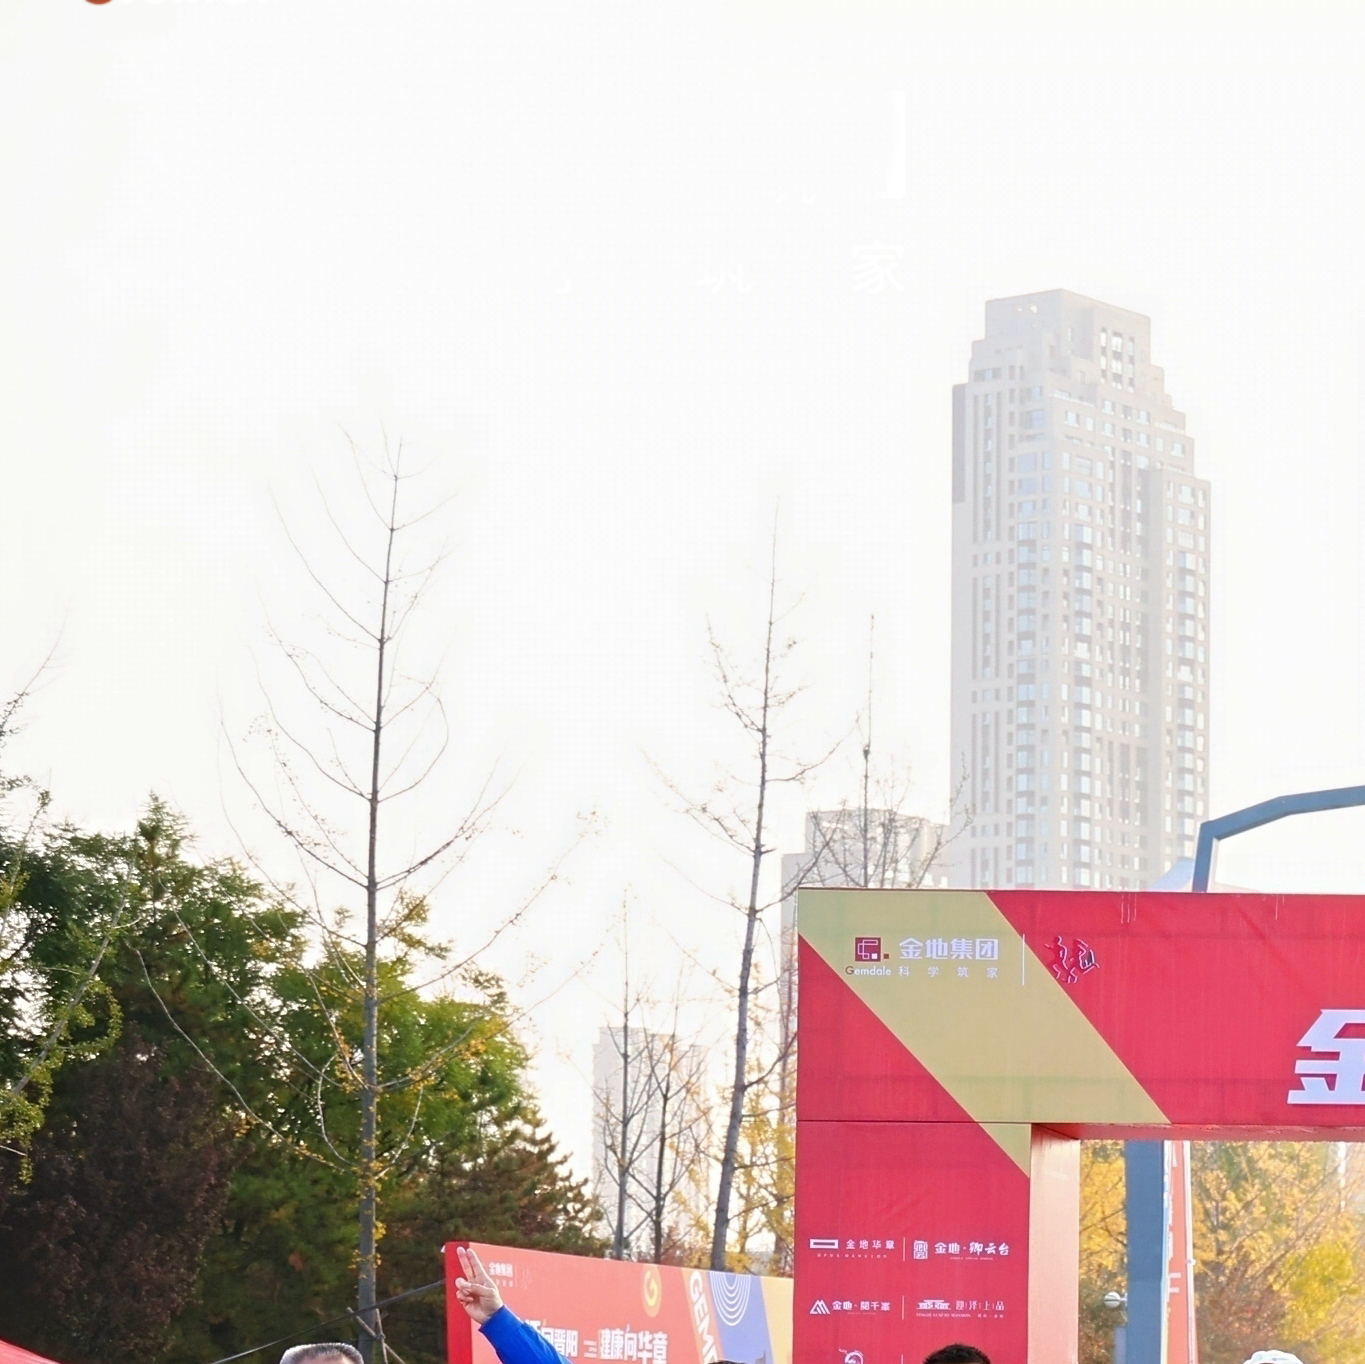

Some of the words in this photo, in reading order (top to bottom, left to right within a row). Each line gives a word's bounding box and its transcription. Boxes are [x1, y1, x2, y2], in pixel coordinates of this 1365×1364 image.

[899, 937, 999, 961] 金地集团
[845, 965, 892, 977] Gemdale
[899, 966, 998, 979] 科学筑家
[846, 1239, 895, 1250] 金地华章
